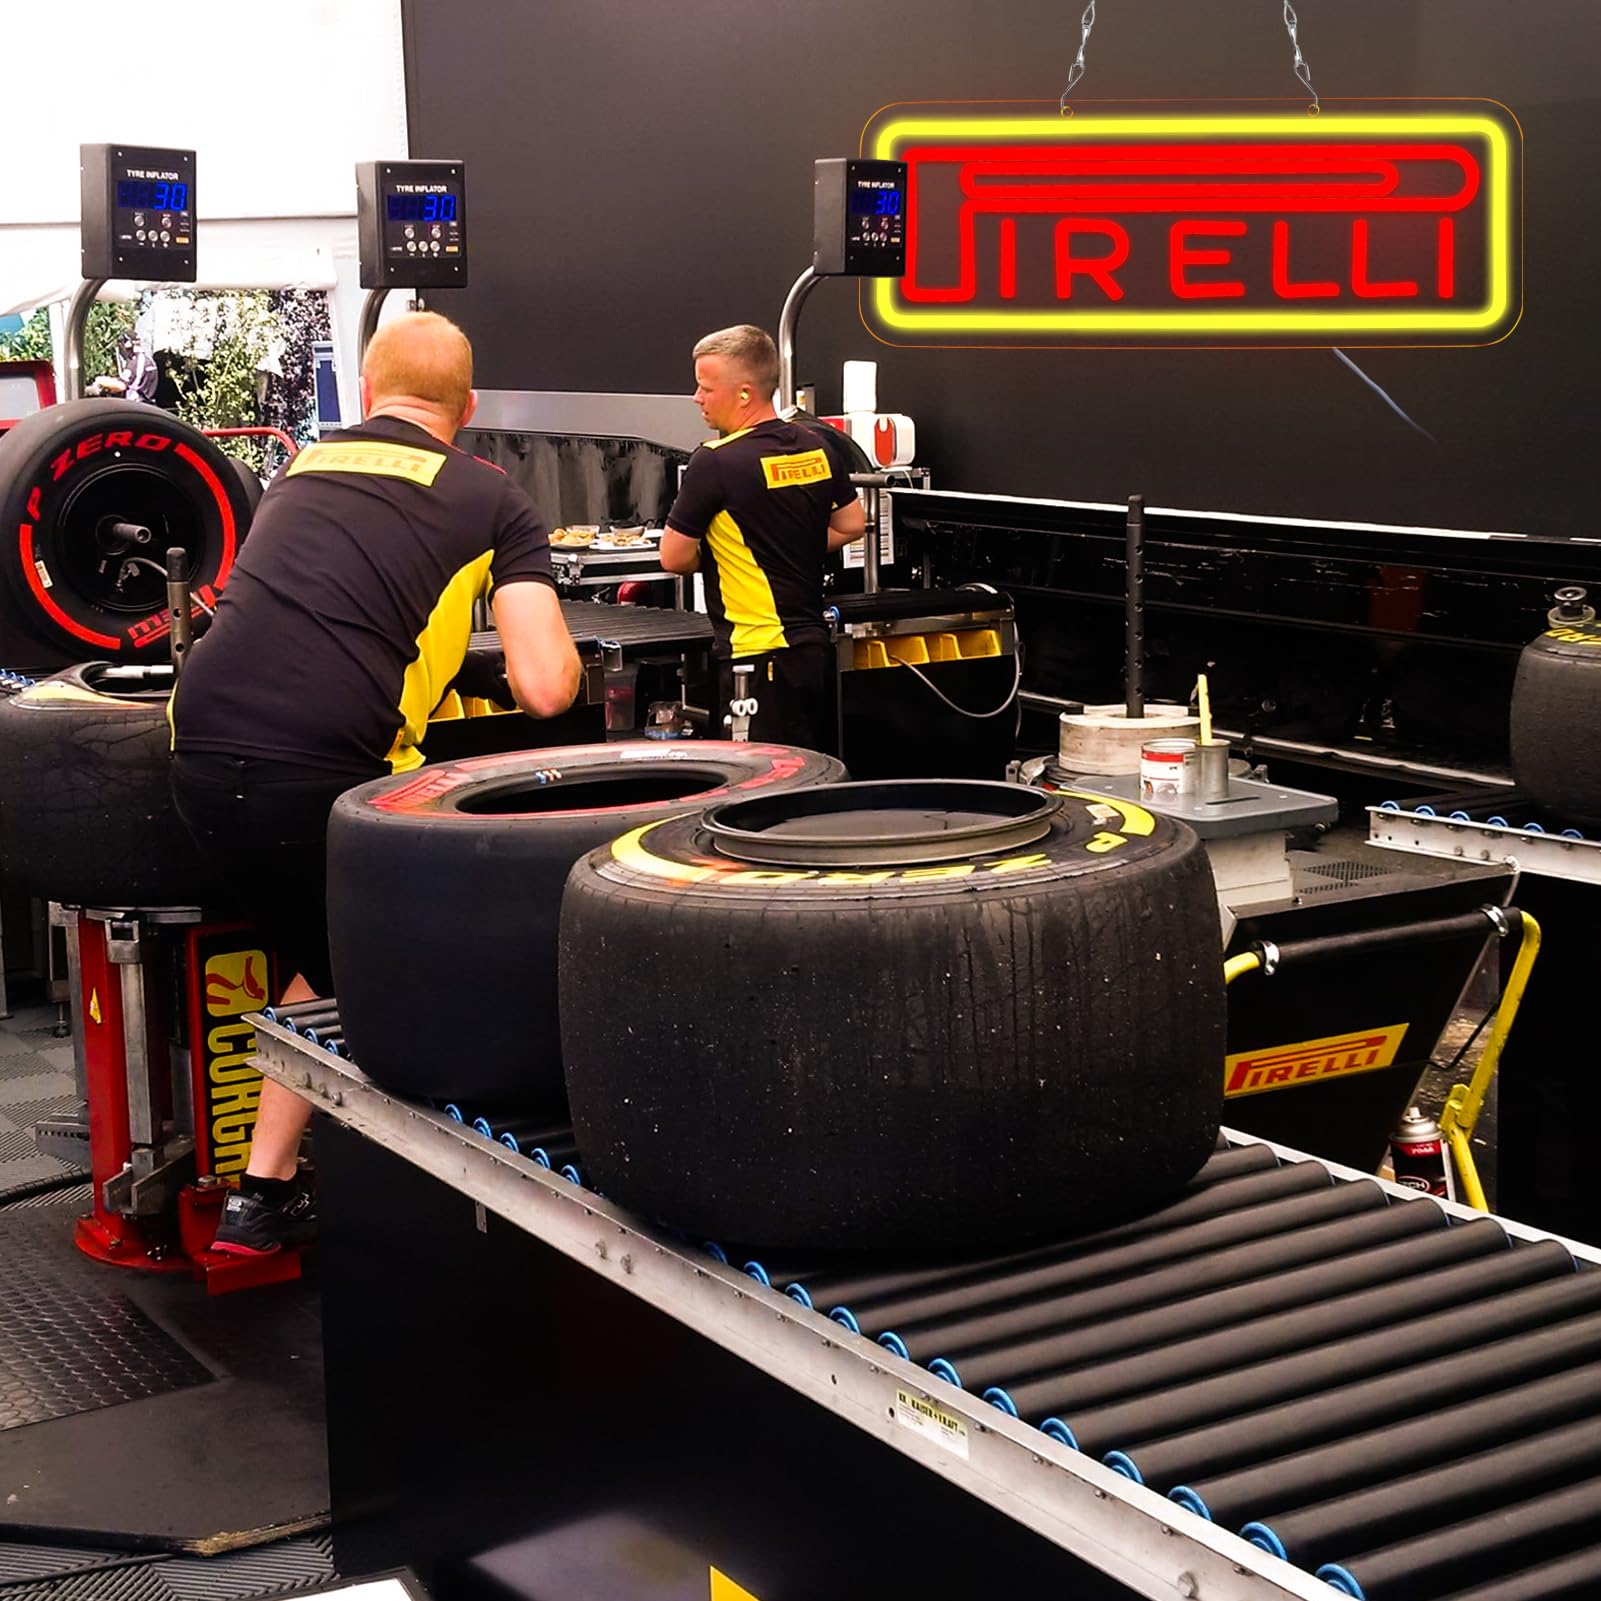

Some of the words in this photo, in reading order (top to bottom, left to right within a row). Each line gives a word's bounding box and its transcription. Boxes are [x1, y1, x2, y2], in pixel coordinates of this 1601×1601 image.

[126, 169, 145, 178] TYRE
[146, 171, 179, 180] INFLATOR
[871, 181, 895, 189] INFLATOR
[152, 181, 187, 211] 30
[396, 184, 414, 193] TYRE
[415, 185, 448, 194] INFLATOR
[423, 194, 456, 221] 30
[875, 191, 899, 215] 30
[902, 144, 1480, 302] PIRELLI
[301, 449, 427, 473] PIRELLI
[771, 457, 826, 481] PIRELLI
[26, 486, 42, 521] P
[50, 431, 174, 481] ZERO
[1086, 832, 1128, 853] P
[719, 853, 1052, 885] ZERO
[1227, 1035, 1387, 1092] PIRELLI
